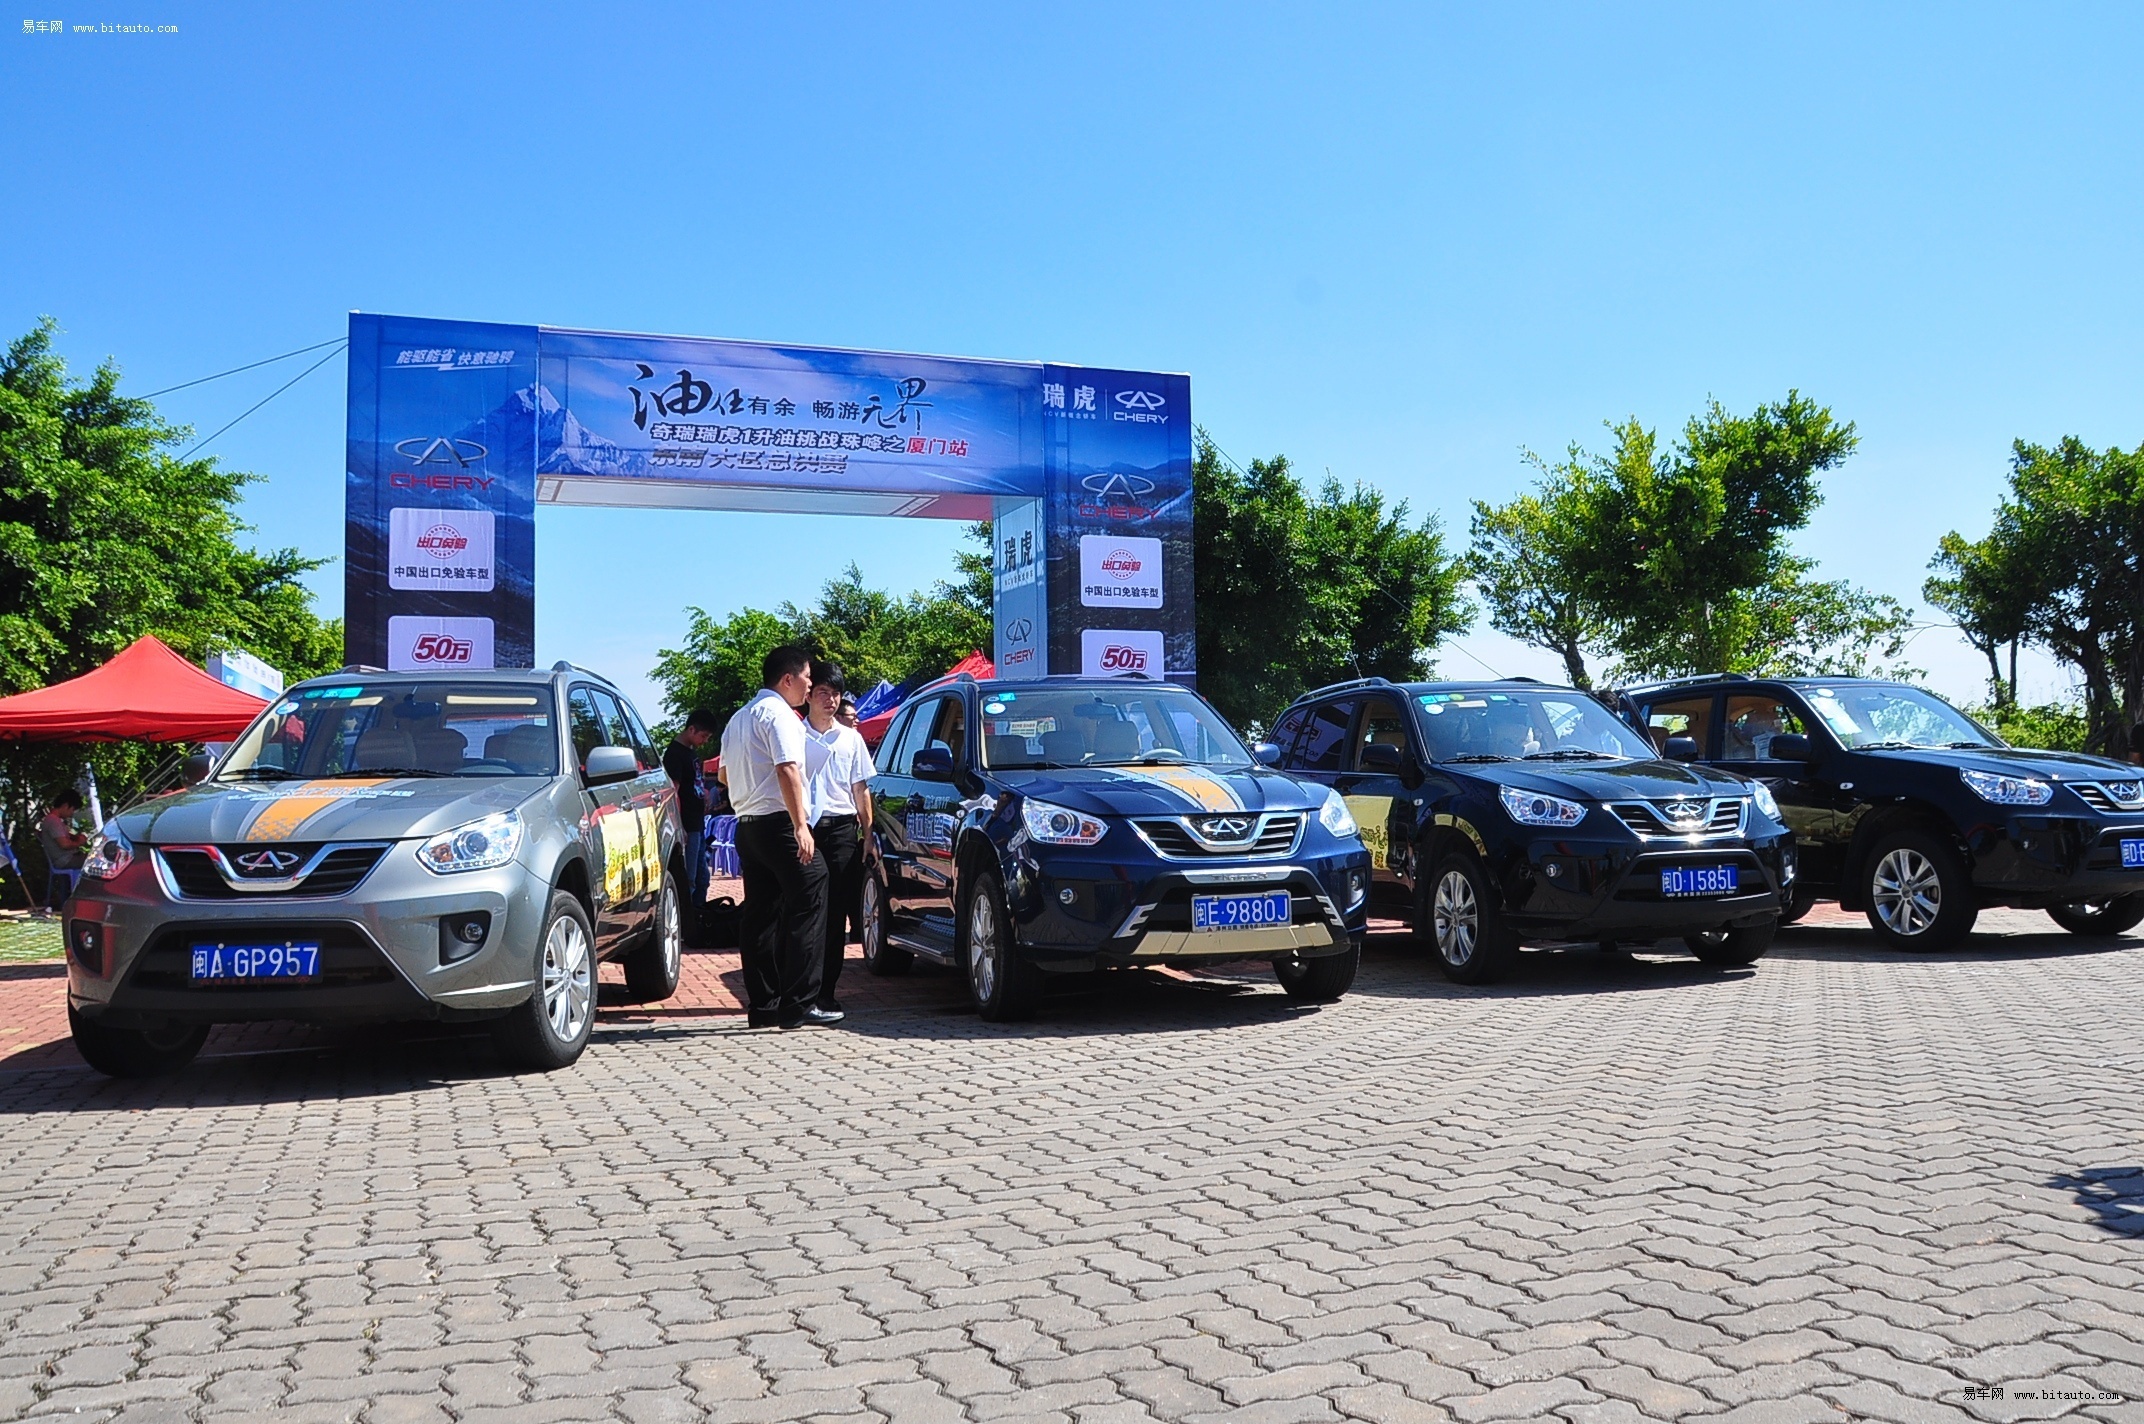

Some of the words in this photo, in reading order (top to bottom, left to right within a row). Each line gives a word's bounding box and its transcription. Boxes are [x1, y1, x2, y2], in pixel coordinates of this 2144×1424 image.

[812, 377, 933, 435] 畅游无界
[1043, 383, 1096, 411] 瑞虎
[1113, 411, 1169, 424] CHERY
[389, 472, 495, 490] CHERY
[1079, 504, 1161, 519] CHERY
[416, 536, 468, 550] 出口免验
[1004, 530, 1033, 572] 瑞虎
[393, 565, 490, 580] 中国出口免验车型
[1084, 585, 1160, 599] 中国出口免验车型
[413, 636, 472, 662] 50万
[1004, 648, 1035, 666] CHERY
[1101, 646, 1147, 670] 50万
